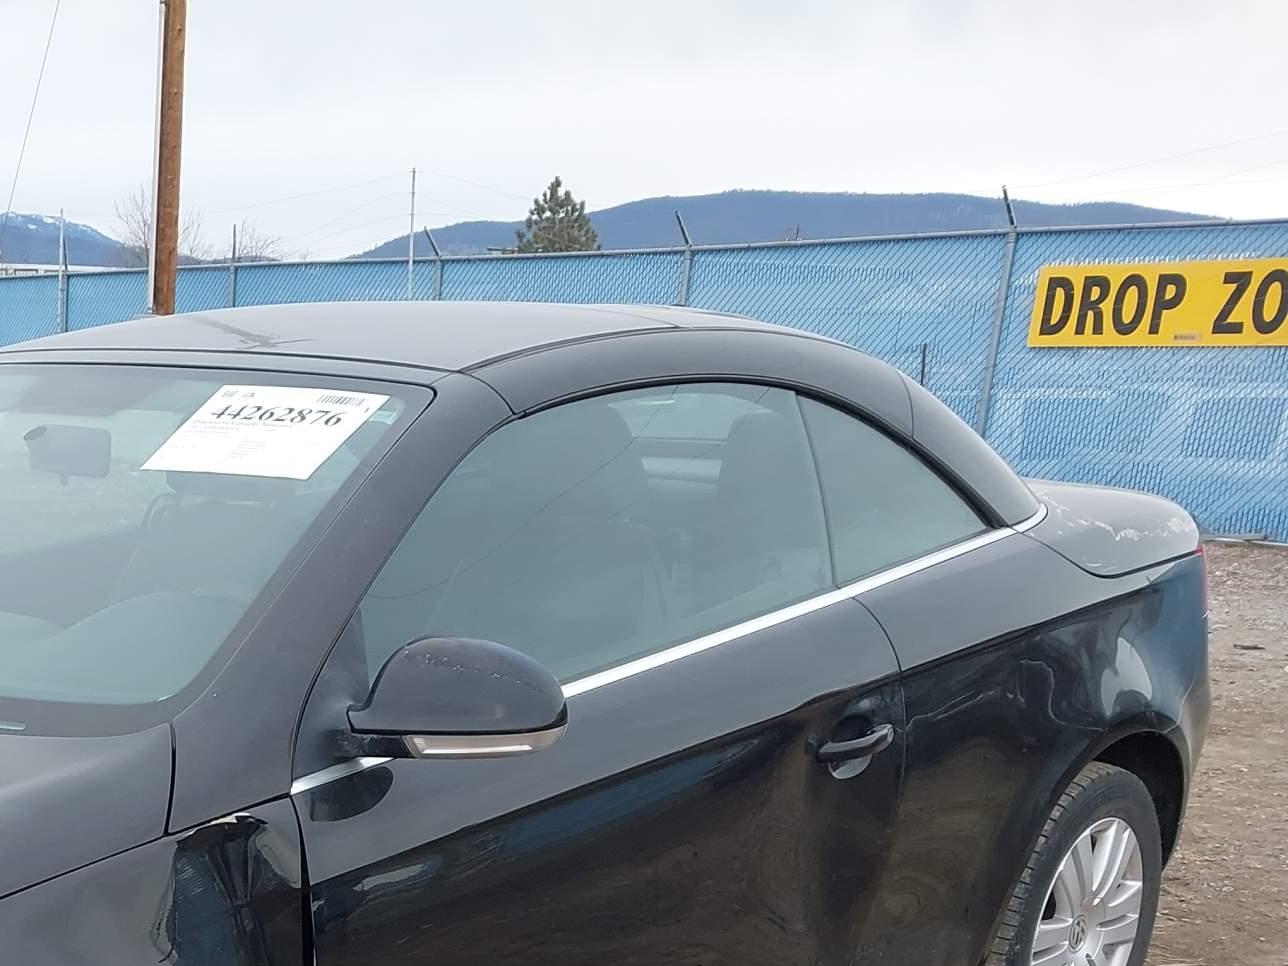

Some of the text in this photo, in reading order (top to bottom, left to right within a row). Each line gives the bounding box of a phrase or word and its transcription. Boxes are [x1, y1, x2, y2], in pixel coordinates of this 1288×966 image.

[1039, 269, 1288, 336] DROP ZO
[211, 403, 348, 427] 44262876
